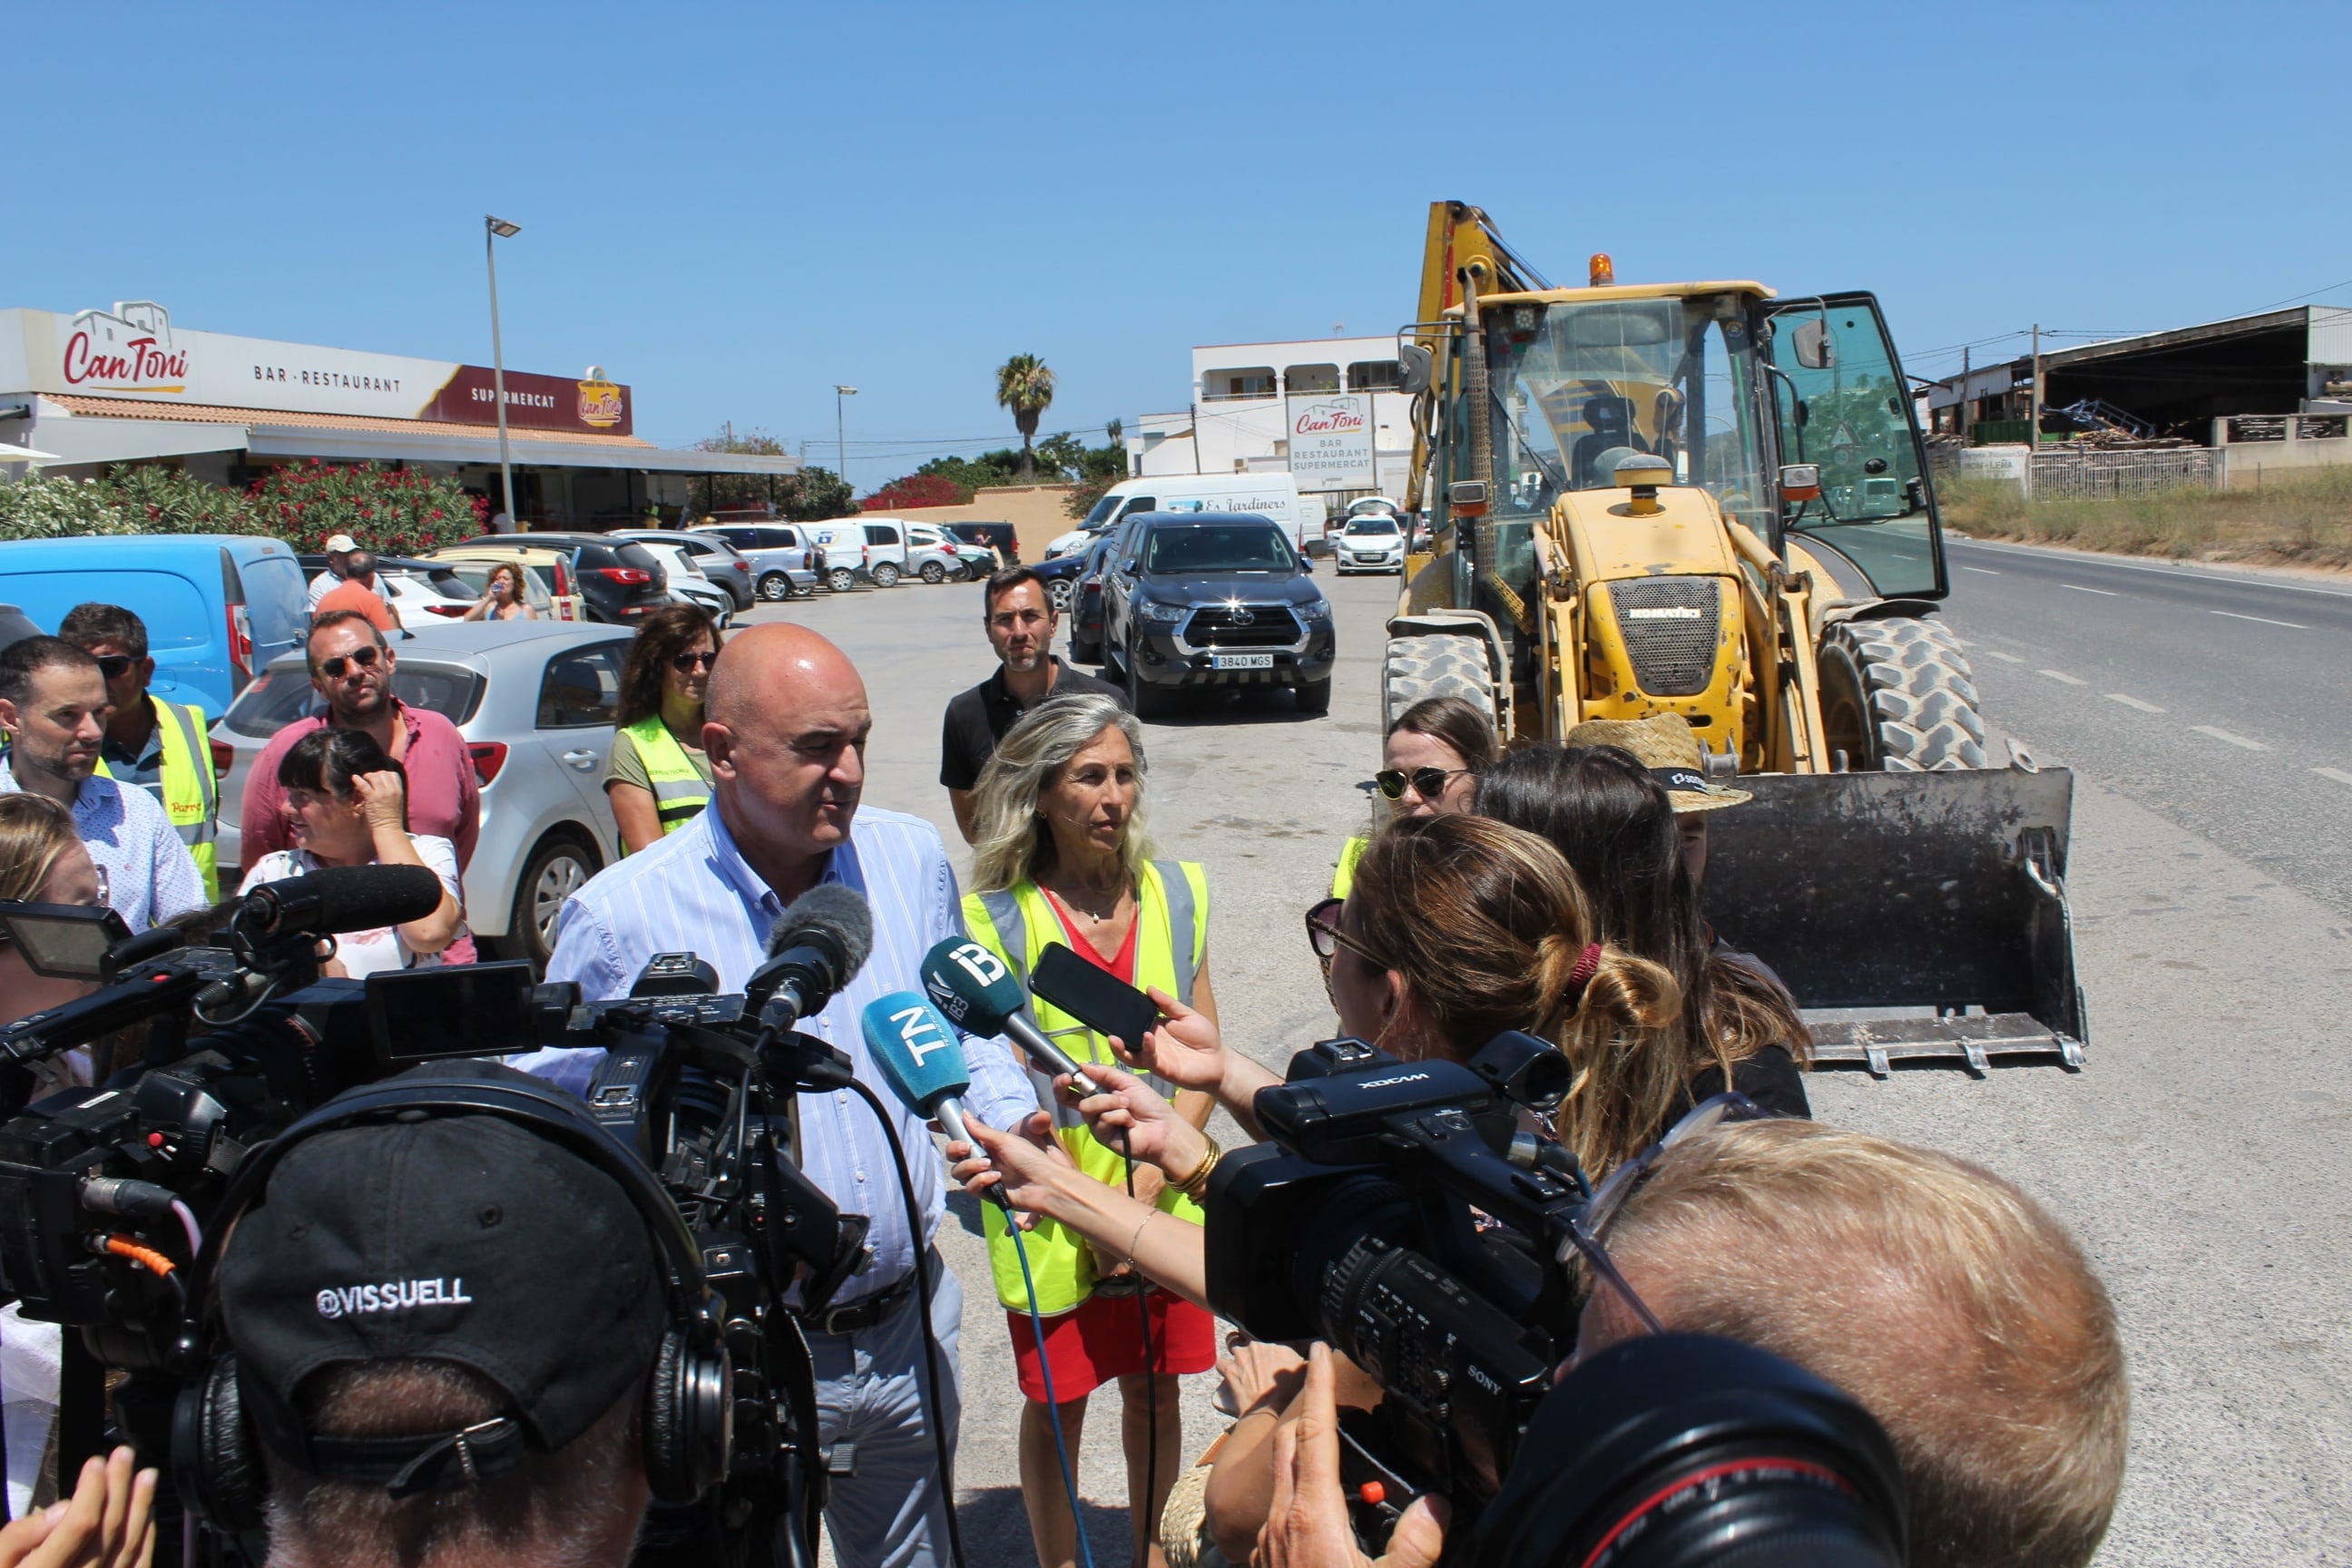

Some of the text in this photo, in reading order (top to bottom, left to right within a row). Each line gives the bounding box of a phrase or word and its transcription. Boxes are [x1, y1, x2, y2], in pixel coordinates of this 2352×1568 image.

[254, 365, 286, 382] BAR
[302, 370, 400, 393] RESTAURANT
[471, 387, 556, 408] SUPRMERCAT
[1319, 439, 1342, 448] BAR
[1294, 449, 1368, 460] RESTAURANT
[1293, 459, 1370, 471] SUPERMERCAT
[1205, 496, 1286, 512] Es Jardiners
[1220, 655, 1270, 667] 3840 MGS
[1357, 1073, 1431, 1089] XDCAM
[316, 1278, 473, 1318] @VISSUELL
[1467, 1364, 1502, 1396] SONY
